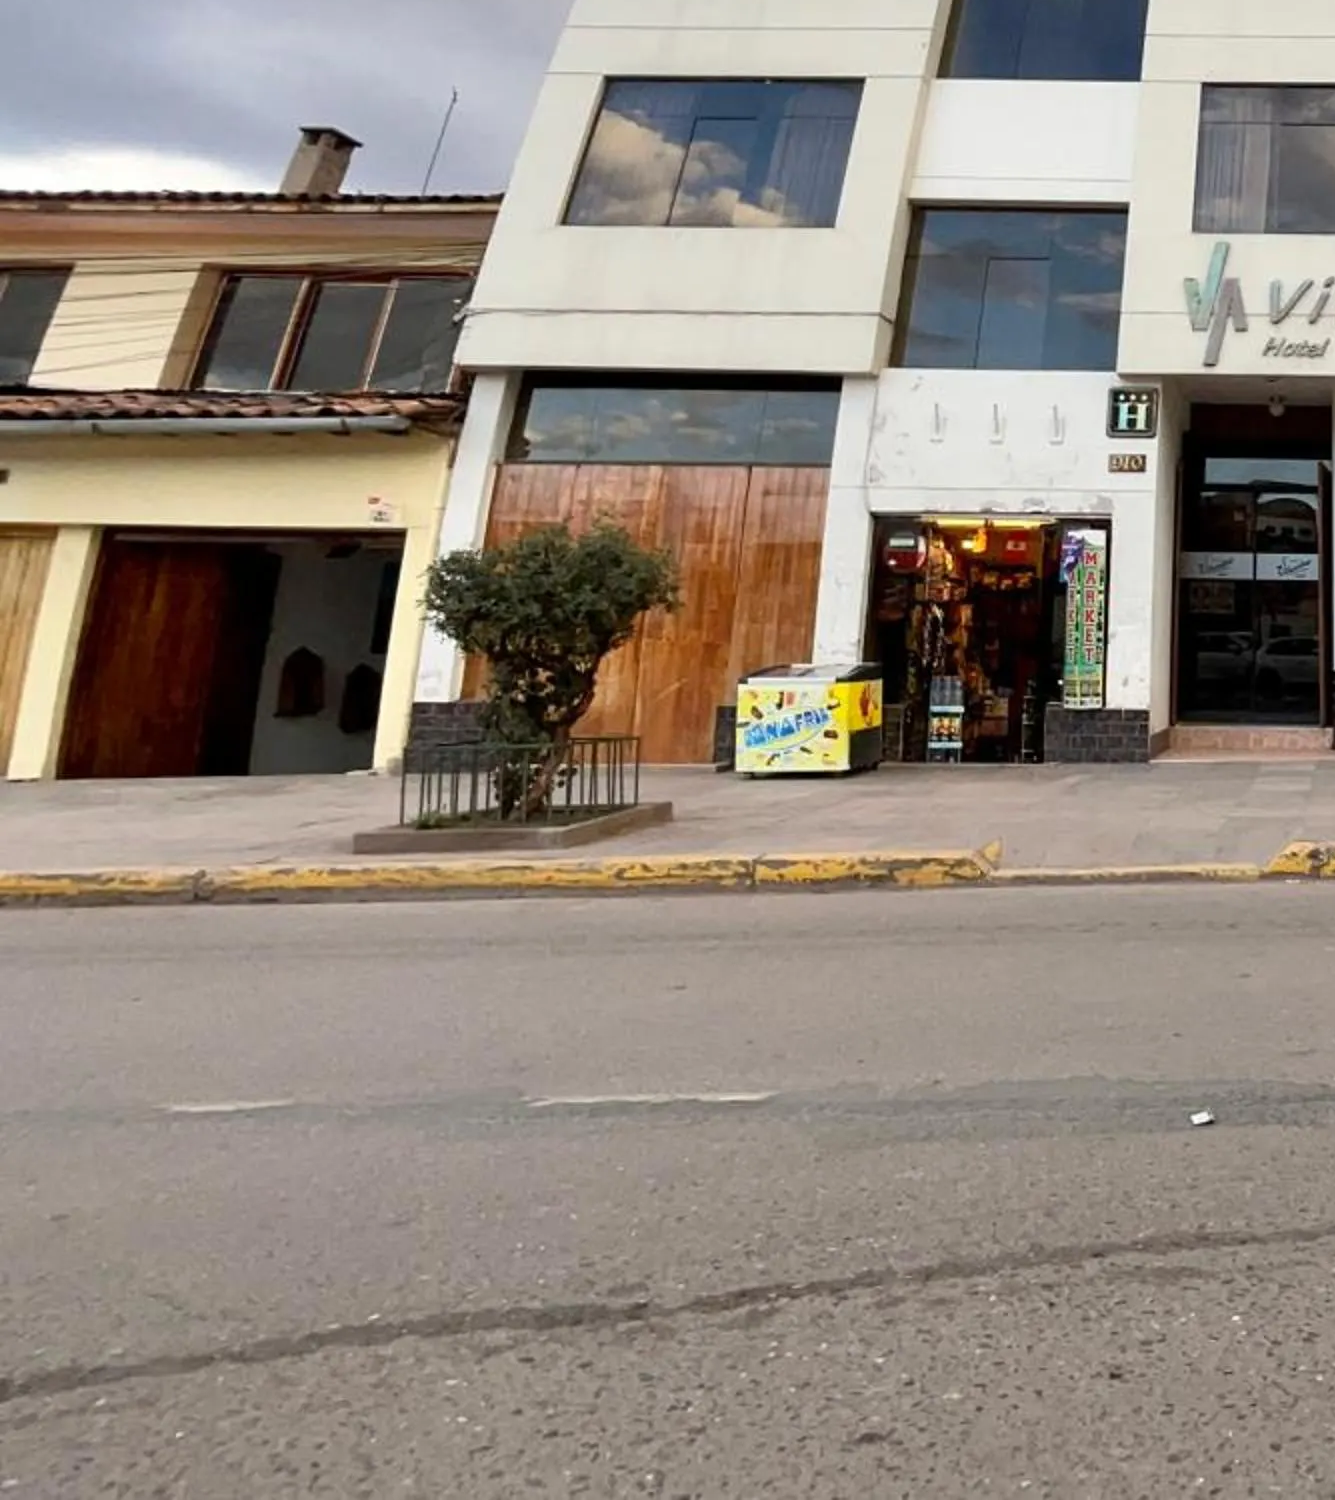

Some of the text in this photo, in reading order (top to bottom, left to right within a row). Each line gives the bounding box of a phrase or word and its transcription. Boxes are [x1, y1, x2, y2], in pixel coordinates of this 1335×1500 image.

[1262, 337, 1331, 358] Hotel
[1116, 402, 1150, 430] H
[1084, 551, 1098, 666] MARKET
